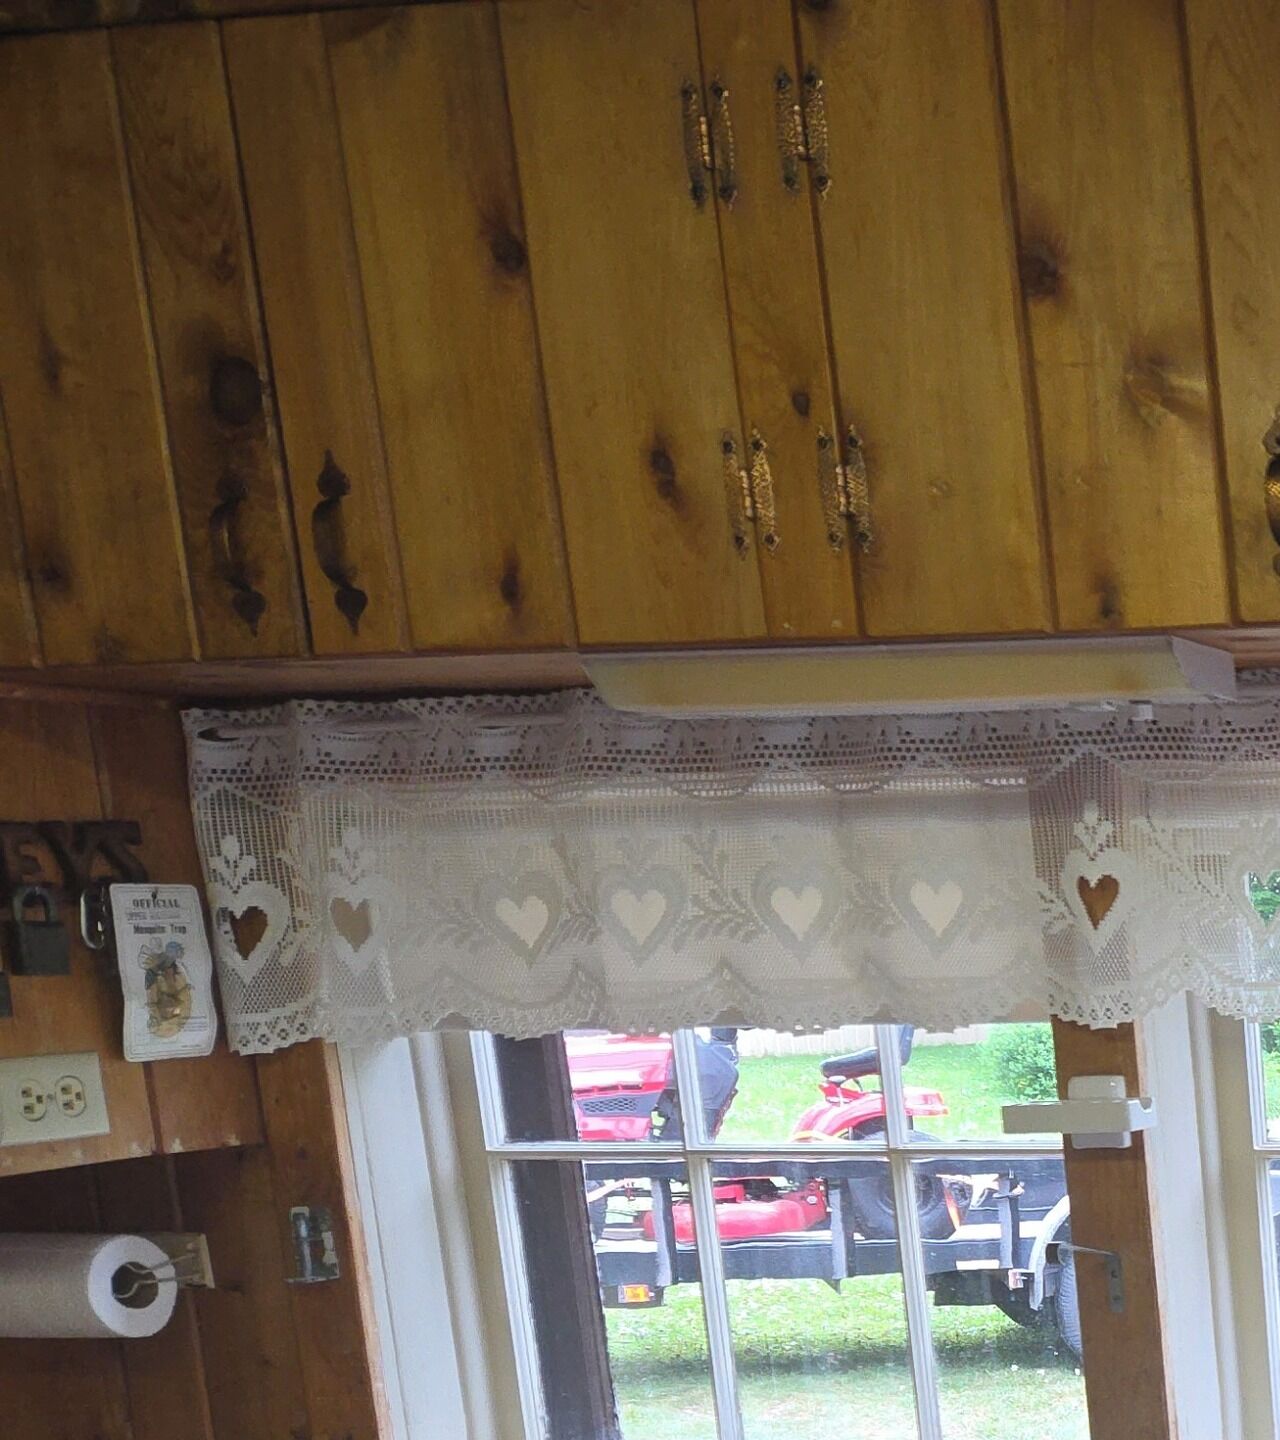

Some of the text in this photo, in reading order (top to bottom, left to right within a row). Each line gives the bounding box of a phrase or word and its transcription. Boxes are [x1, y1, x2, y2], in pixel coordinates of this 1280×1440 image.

[0, 820, 149, 906] EYS
[132, 898, 181, 909] OFFICIAL
[170, 924, 187, 935] Trap
